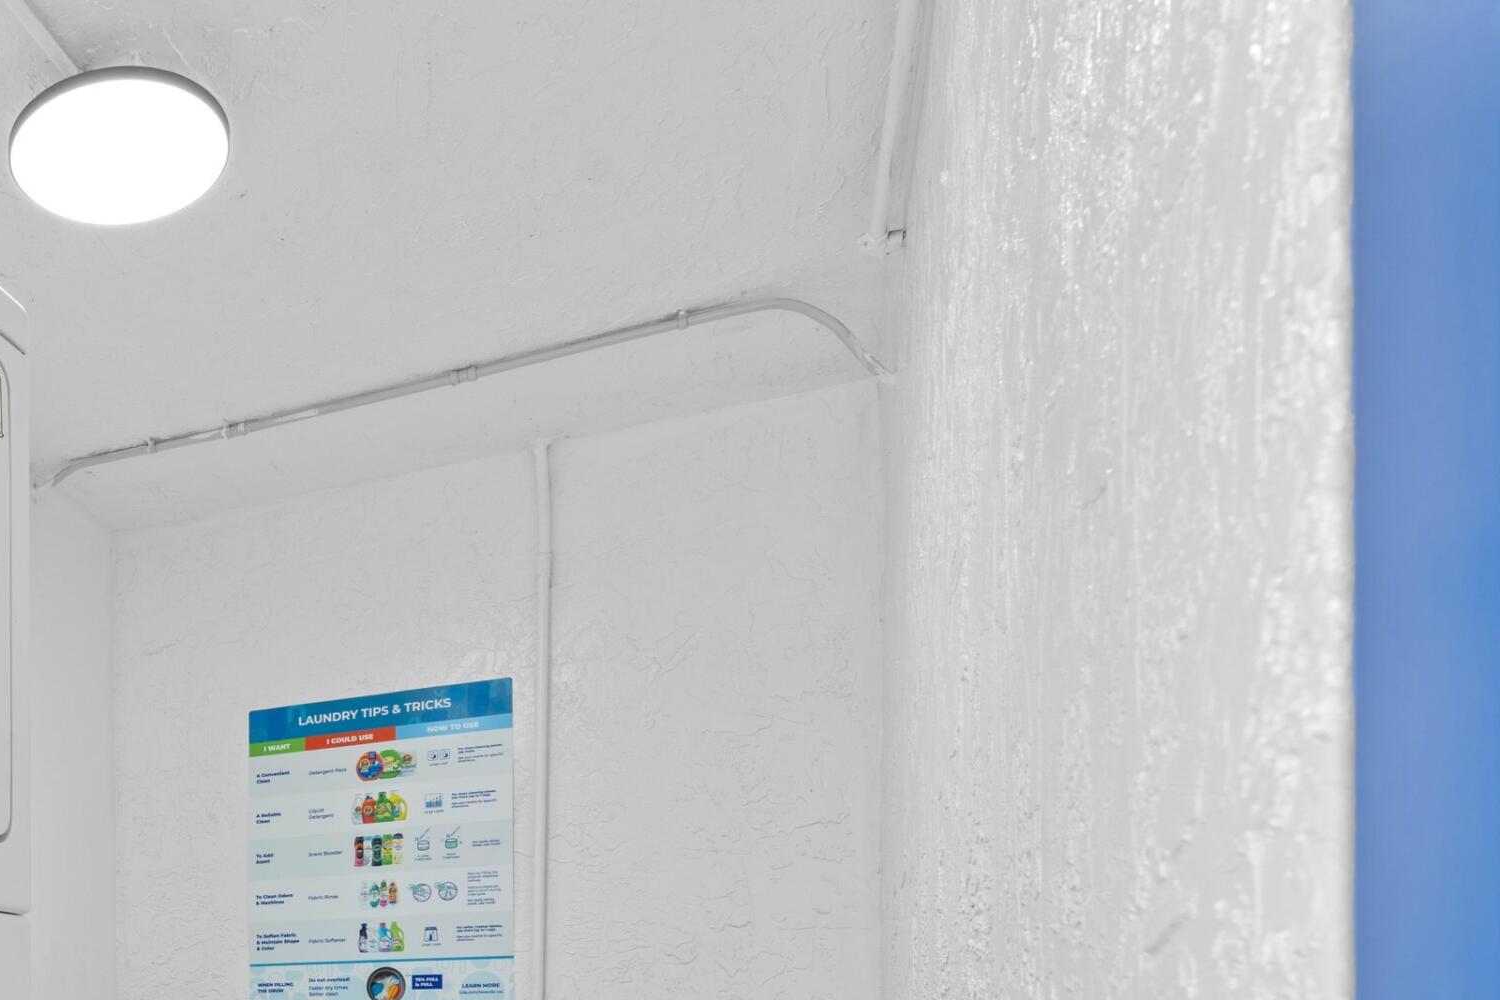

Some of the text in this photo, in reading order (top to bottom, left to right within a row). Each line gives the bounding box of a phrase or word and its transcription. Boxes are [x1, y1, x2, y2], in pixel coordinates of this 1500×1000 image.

[298, 697, 452, 726] LAUNDRY TIPS & TRICKS
[450, 723, 461, 731] TO
[463, 721, 480, 729] USE
[331, 735, 357, 744] COULD
[359, 733, 373, 741] USE
[268, 743, 291, 752] WANT
